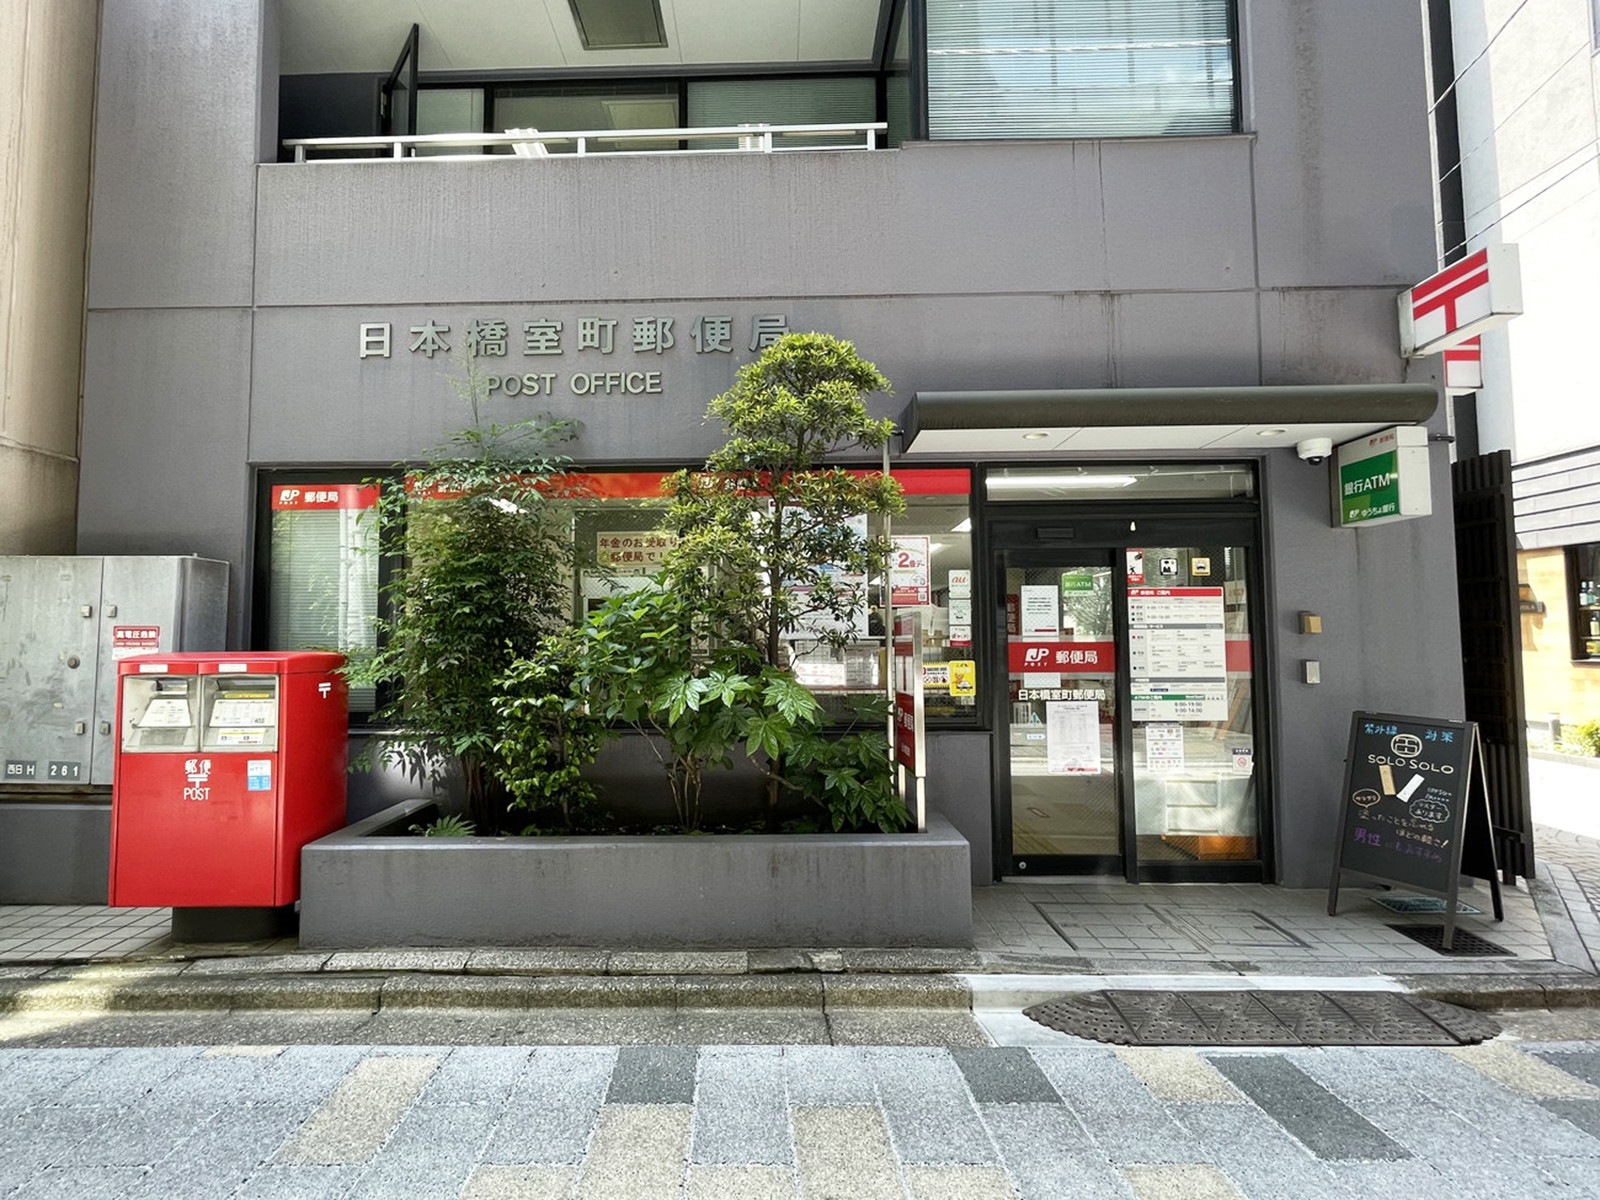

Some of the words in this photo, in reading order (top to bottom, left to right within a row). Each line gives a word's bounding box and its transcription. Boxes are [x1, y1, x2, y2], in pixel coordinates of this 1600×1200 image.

[359, 313, 790, 358] 日本橋室町郵便局
[487, 373, 558, 397] POST
[570, 371, 663, 395] OFFICE
[1344, 472, 1390, 495] 銀行ATM
[304, 491, 339, 503] 郵便局
[1361, 502, 1395, 517] ゆうちょ銀行
[1055, 650, 1098, 665] 郵便局
[1018, 688, 1106, 701] 日本橋室町郵便局
[1424, 729, 1454, 743] 対策
[50, 764, 79, 777] 261
[184, 759, 212, 775] 郵便
[1367, 754, 1406, 768] SOLO
[1408, 759, 1454, 775] SOLO
[183, 787, 211, 801] POST
